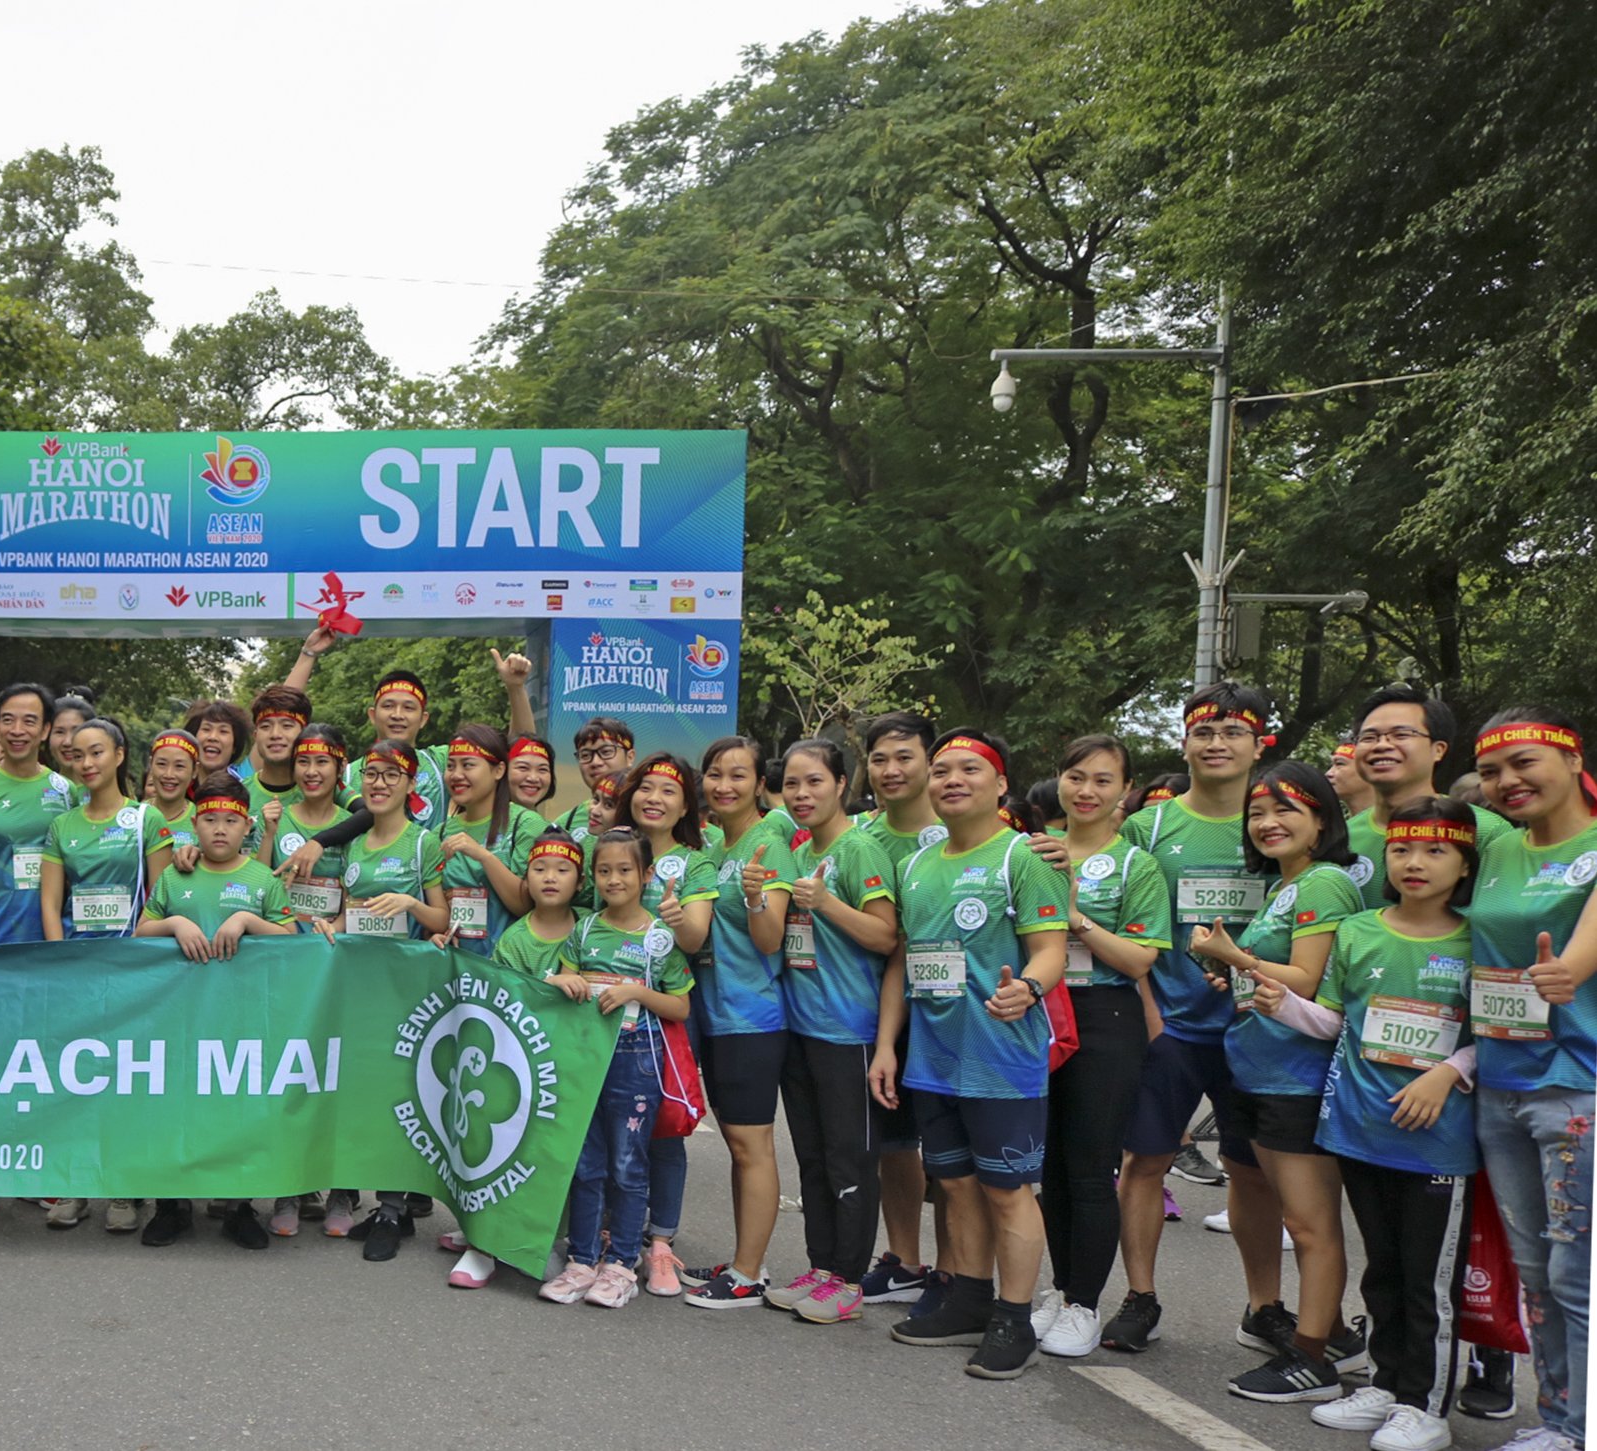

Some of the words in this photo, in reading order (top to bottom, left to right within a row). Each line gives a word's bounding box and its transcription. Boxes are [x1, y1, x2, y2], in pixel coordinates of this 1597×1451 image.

[67, 442, 129, 458] VPBank
[28, 458, 145, 487] HANOI
[359, 446, 660, 549] START
[0, 491, 171, 541] MARATHON
[207, 513, 263, 533] ASEAN
[57, 552, 100, 567] HANOI
[104, 552, 182, 567] MARATHON
[184, 552, 232, 567] ASEAN
[234, 552, 268, 567] 2020
[195, 590, 266, 608] VPBank
[605, 636, 644, 647] VPBank
[581, 646, 653, 664] HANOI
[563, 666, 669, 697] MARATHON
[689, 680, 725, 693] ASEAN
[562, 702, 597, 712] VPBANK
[598, 703, 625, 712] HANOI
[627, 703, 675, 713] MARATHON
[676, 704, 704, 714] ASEAN
[706, 704, 727, 714] 2020
[951, 740, 972, 748] MAI
[1482, 734, 1501, 748] MAI
[1504, 726, 1541, 741] CHIẾN
[290, 891, 328, 910] 50835
[1194, 889, 1246, 907] 52387
[83, 904, 119, 919] 52409
[451, 907, 474, 922] 839
[358, 916, 395, 932] 50837
[784, 935, 803, 952] 970
[914, 963, 949, 981] 52386
[1483, 994, 1526, 1018] 50733
[1381, 1022, 1440, 1049] 51097
[394, 992, 444, 1058] BỆNH
[493, 987, 551, 1054] BẠCH
[536, 1061, 557, 1119] MAI
[196, 1036, 342, 1097] MAI
[394, 1100, 441, 1165] BACH
[458, 1160, 536, 1212] HOSPITAL
